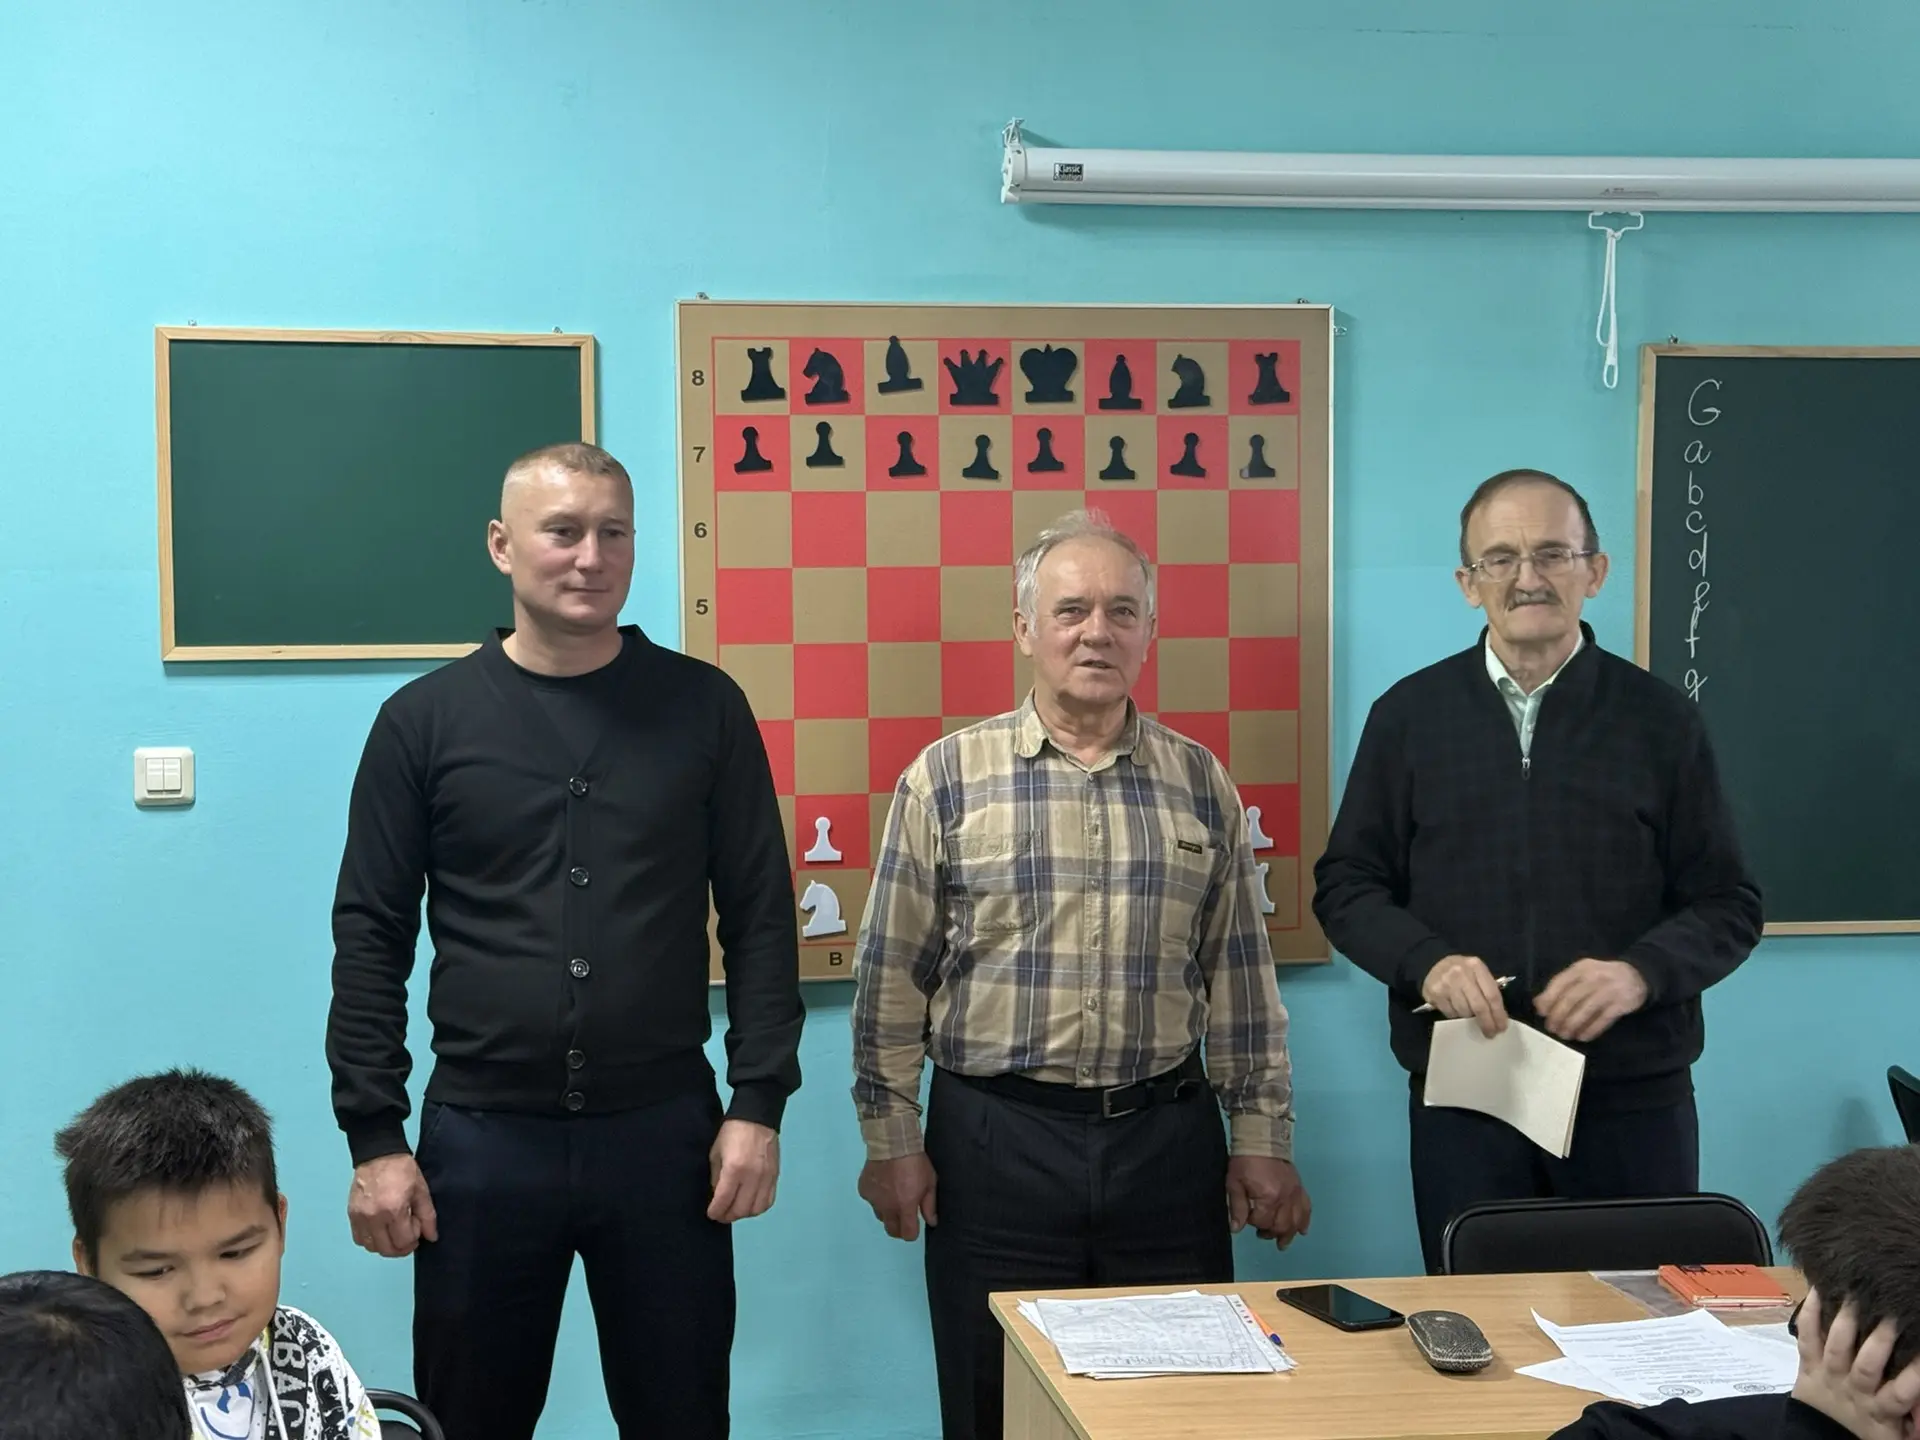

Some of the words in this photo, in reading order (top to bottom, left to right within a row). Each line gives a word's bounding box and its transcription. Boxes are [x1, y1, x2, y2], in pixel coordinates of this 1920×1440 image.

[691, 370, 705, 386] 8
[1688, 379, 1722, 425] G
[693, 446, 706, 463] 7
[1684, 440, 1711, 464] a
[1688, 470, 1704, 505] b
[694, 522, 708, 538] 6
[1686, 510, 1706, 533] c
[1688, 532, 1707, 577] d
[695, 599, 709, 615] 5
[829, 951, 844, 966] B
